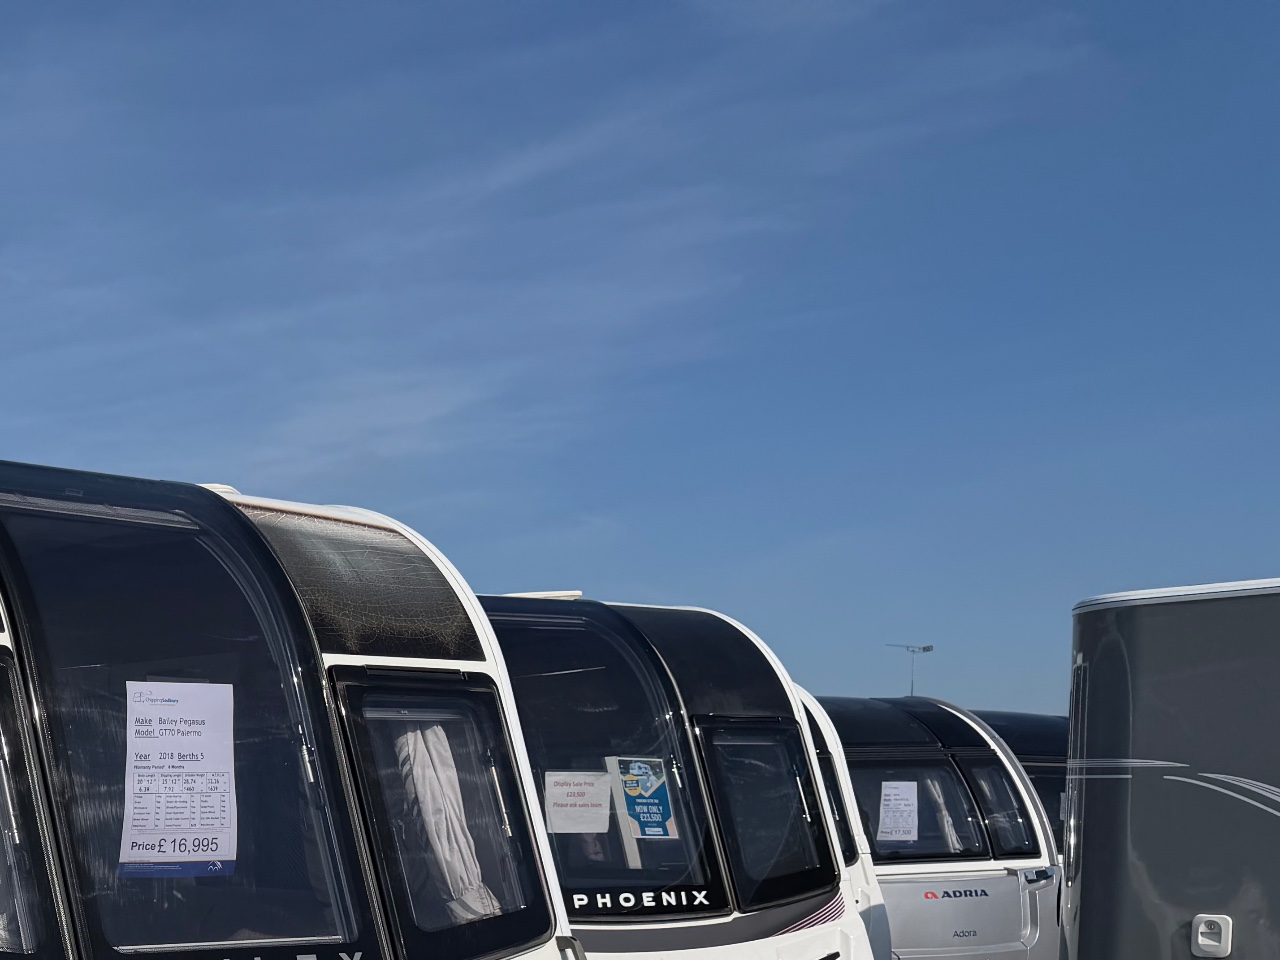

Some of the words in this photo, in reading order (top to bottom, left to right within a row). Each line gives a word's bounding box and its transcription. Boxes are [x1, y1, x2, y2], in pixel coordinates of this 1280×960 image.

[134, 717, 153, 725] Make
[158, 717, 178, 726] Bailey
[179, 718, 206, 727] Pegasus
[134, 729, 155, 737] Model
[158, 729, 176, 737] GT70
[176, 729, 202, 737] Palermo
[134, 752, 151, 760] Year
[158, 752, 174, 760] 2018
[177, 752, 199, 760] Berths
[200, 752, 205, 760] 5
[648, 805, 663, 814] ONLY
[130, 841, 156, 851] Price
[941, 889, 989, 899] ADRIA
[572, 890, 710, 909] PHOENIX
[952, 929, 978, 939] Adora
